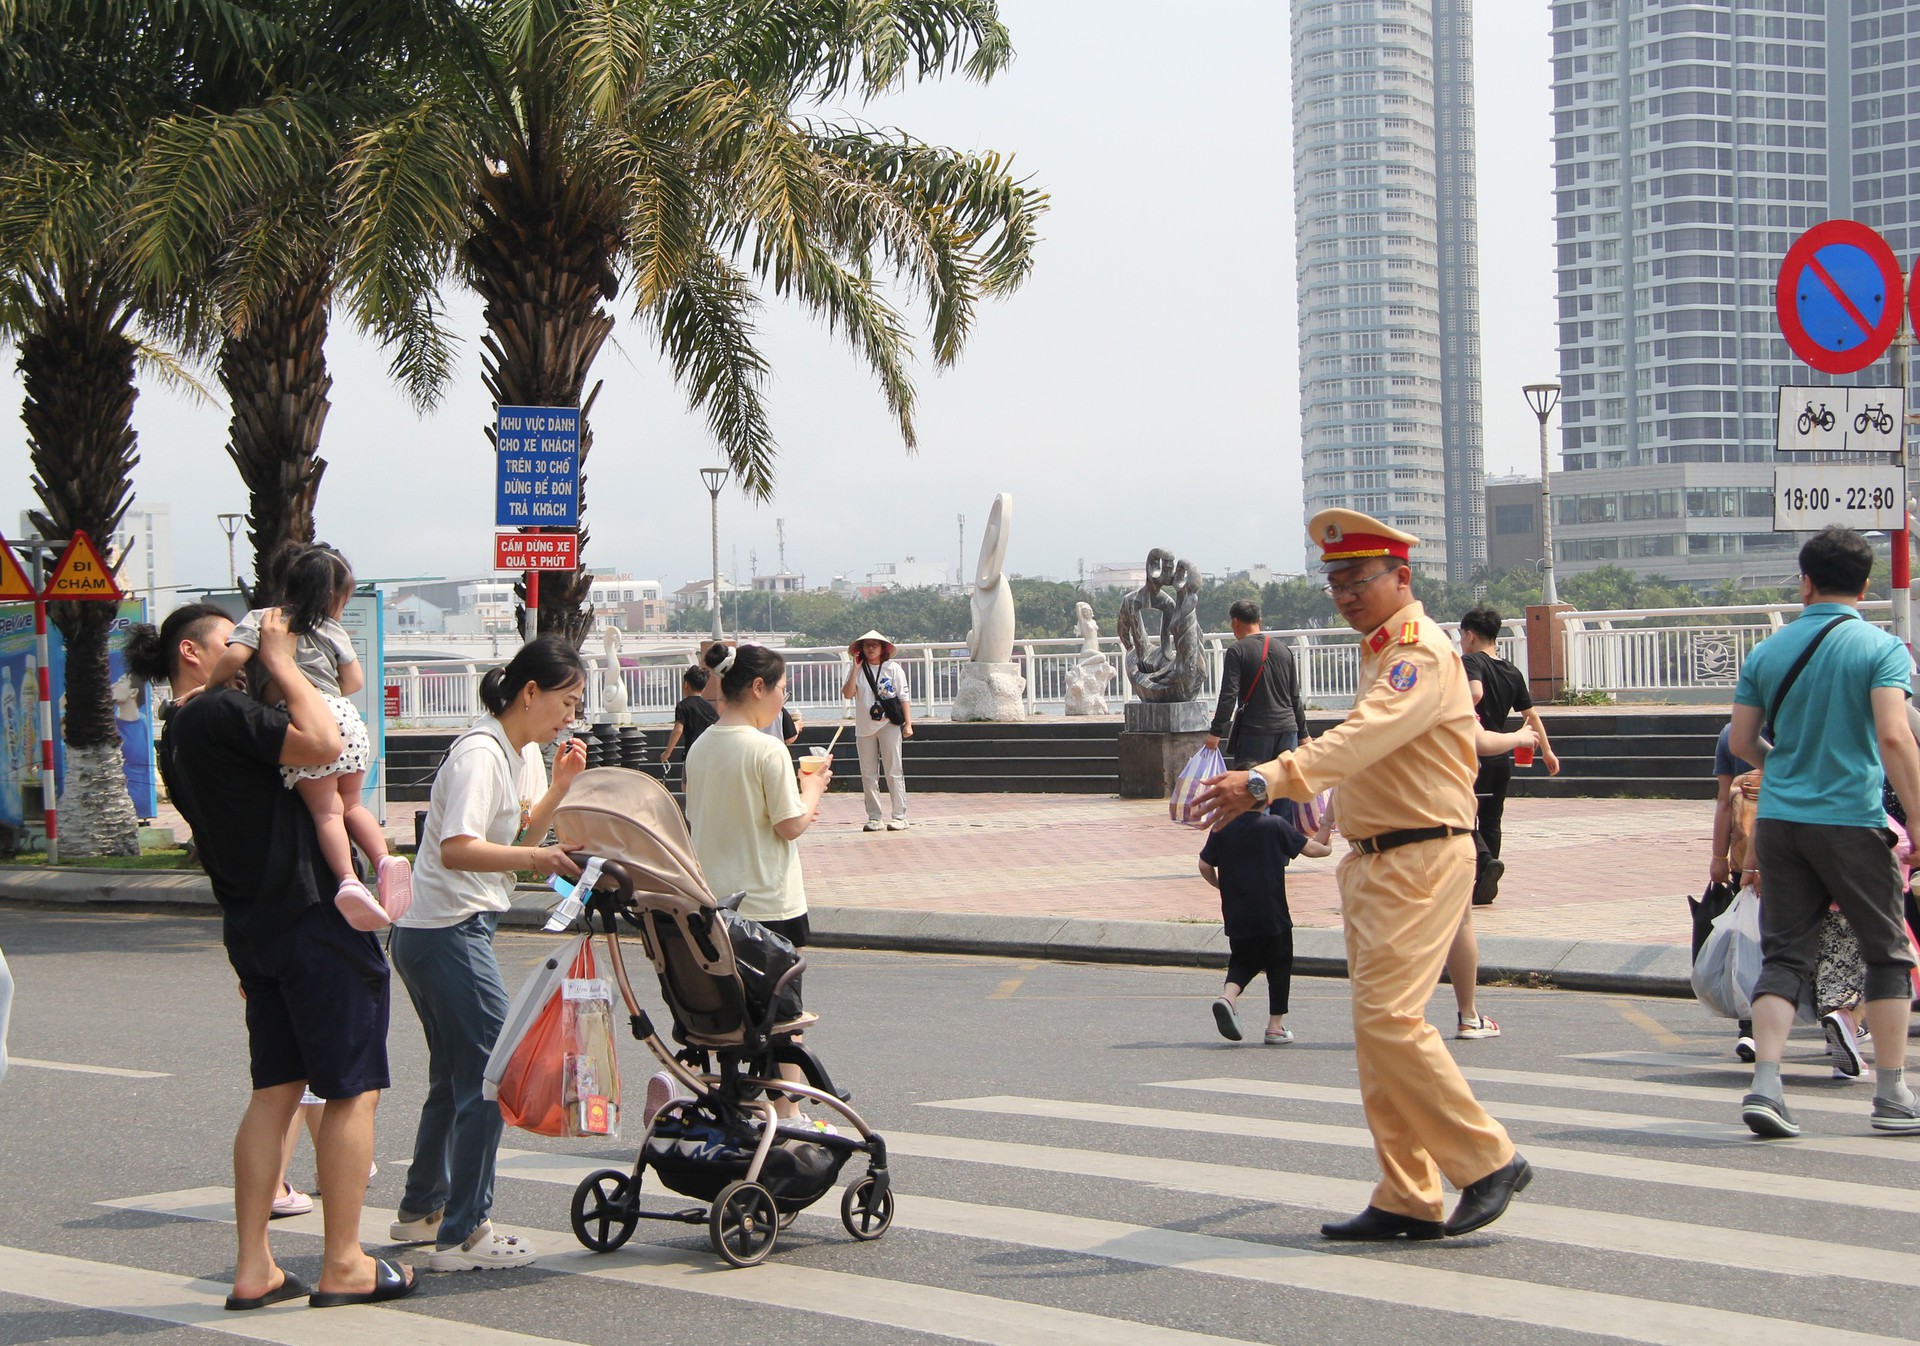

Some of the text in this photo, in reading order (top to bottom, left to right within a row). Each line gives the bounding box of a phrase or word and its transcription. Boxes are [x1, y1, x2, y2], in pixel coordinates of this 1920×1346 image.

[501, 415, 575, 434] KHU VỰC DÀNH
[500, 436, 575, 453] CHO XE KHÁCH
[505, 457, 571, 474] TRÊN 30 CHỖ
[504, 476, 572, 495] DỪNG ĐỂ ĐÓN
[509, 498, 567, 516] TRẢ KHÁCH
[1784, 487, 1830, 511] 18:00
[1846, 487, 1894, 511] 22:30
[501, 538, 571, 553] CẤM DỪNG XE
[73, 561, 92, 572] ĐI
[505, 554, 567, 567] QUÁ 5 PHÚT
[57, 577, 106, 592] CHẬM
